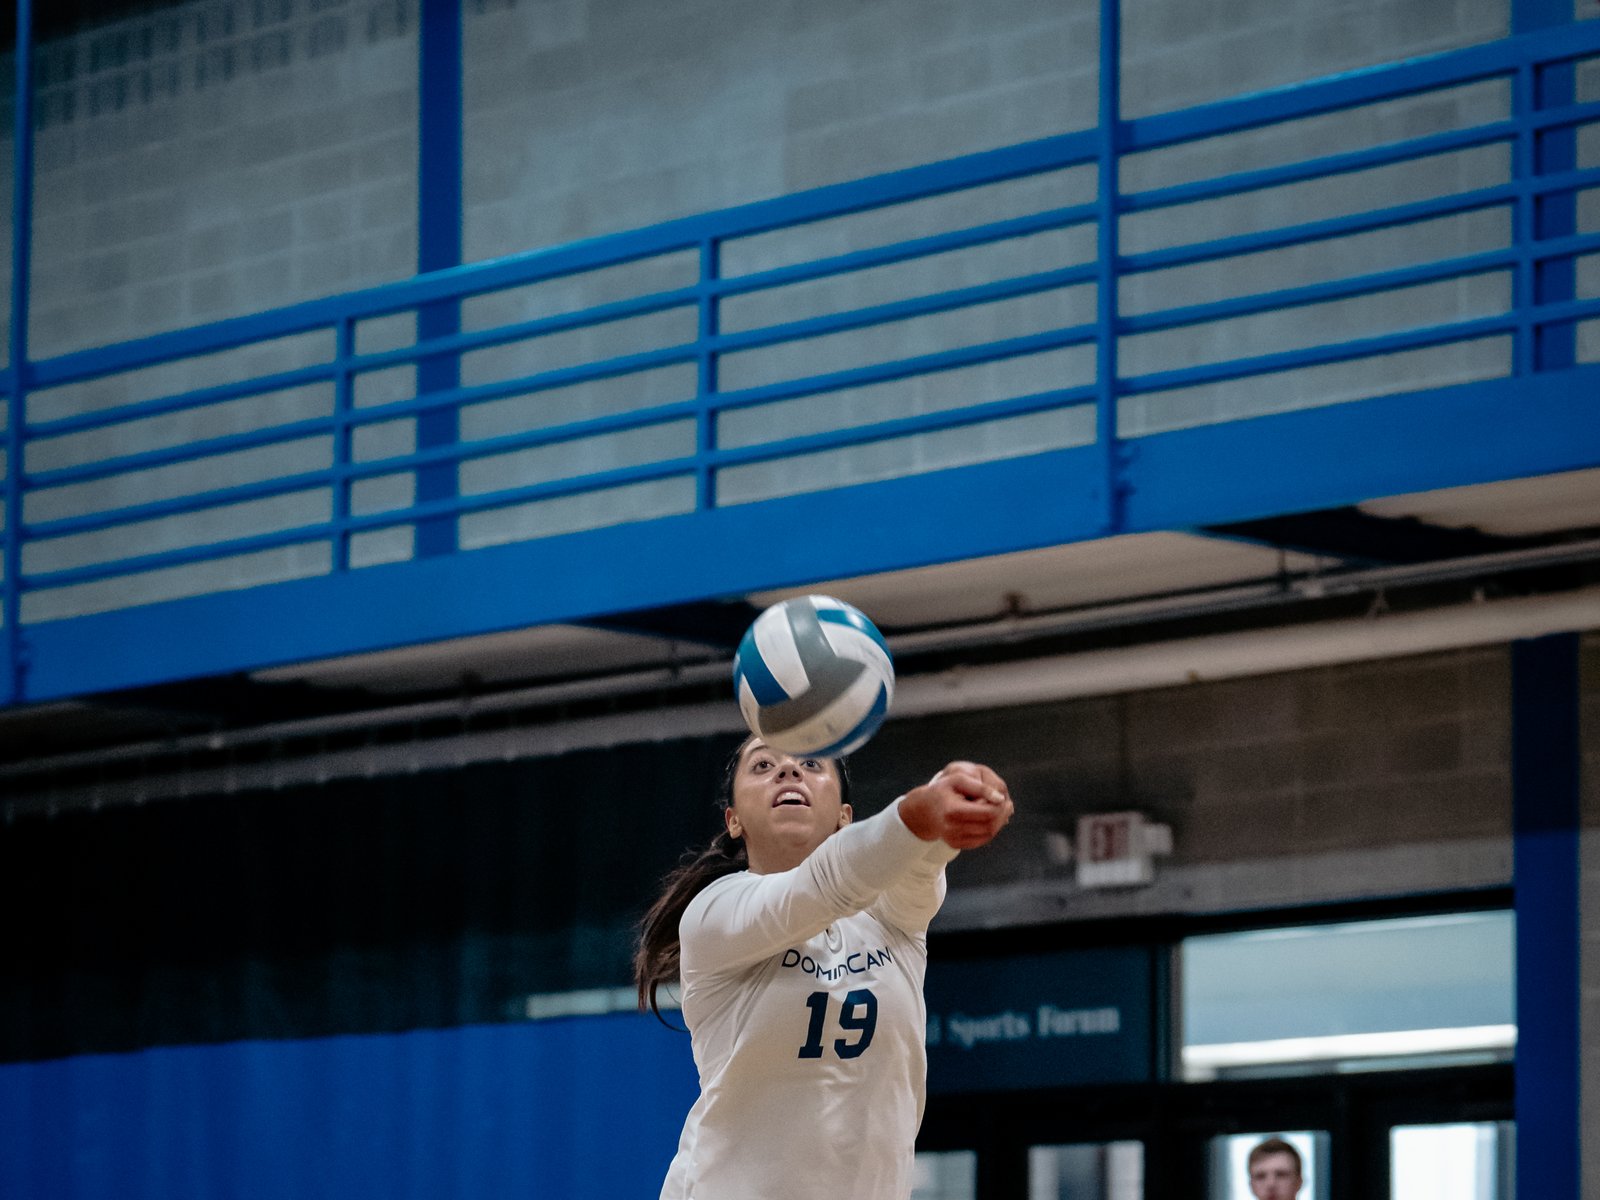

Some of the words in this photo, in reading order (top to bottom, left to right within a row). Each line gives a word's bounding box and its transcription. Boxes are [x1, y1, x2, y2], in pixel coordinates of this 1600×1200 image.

[781, 947, 893, 981] DOMINCAN
[798, 988, 878, 1060] 19
[950, 1011, 1031, 1048] Sports
[1037, 1005, 1121, 1037] Forum
